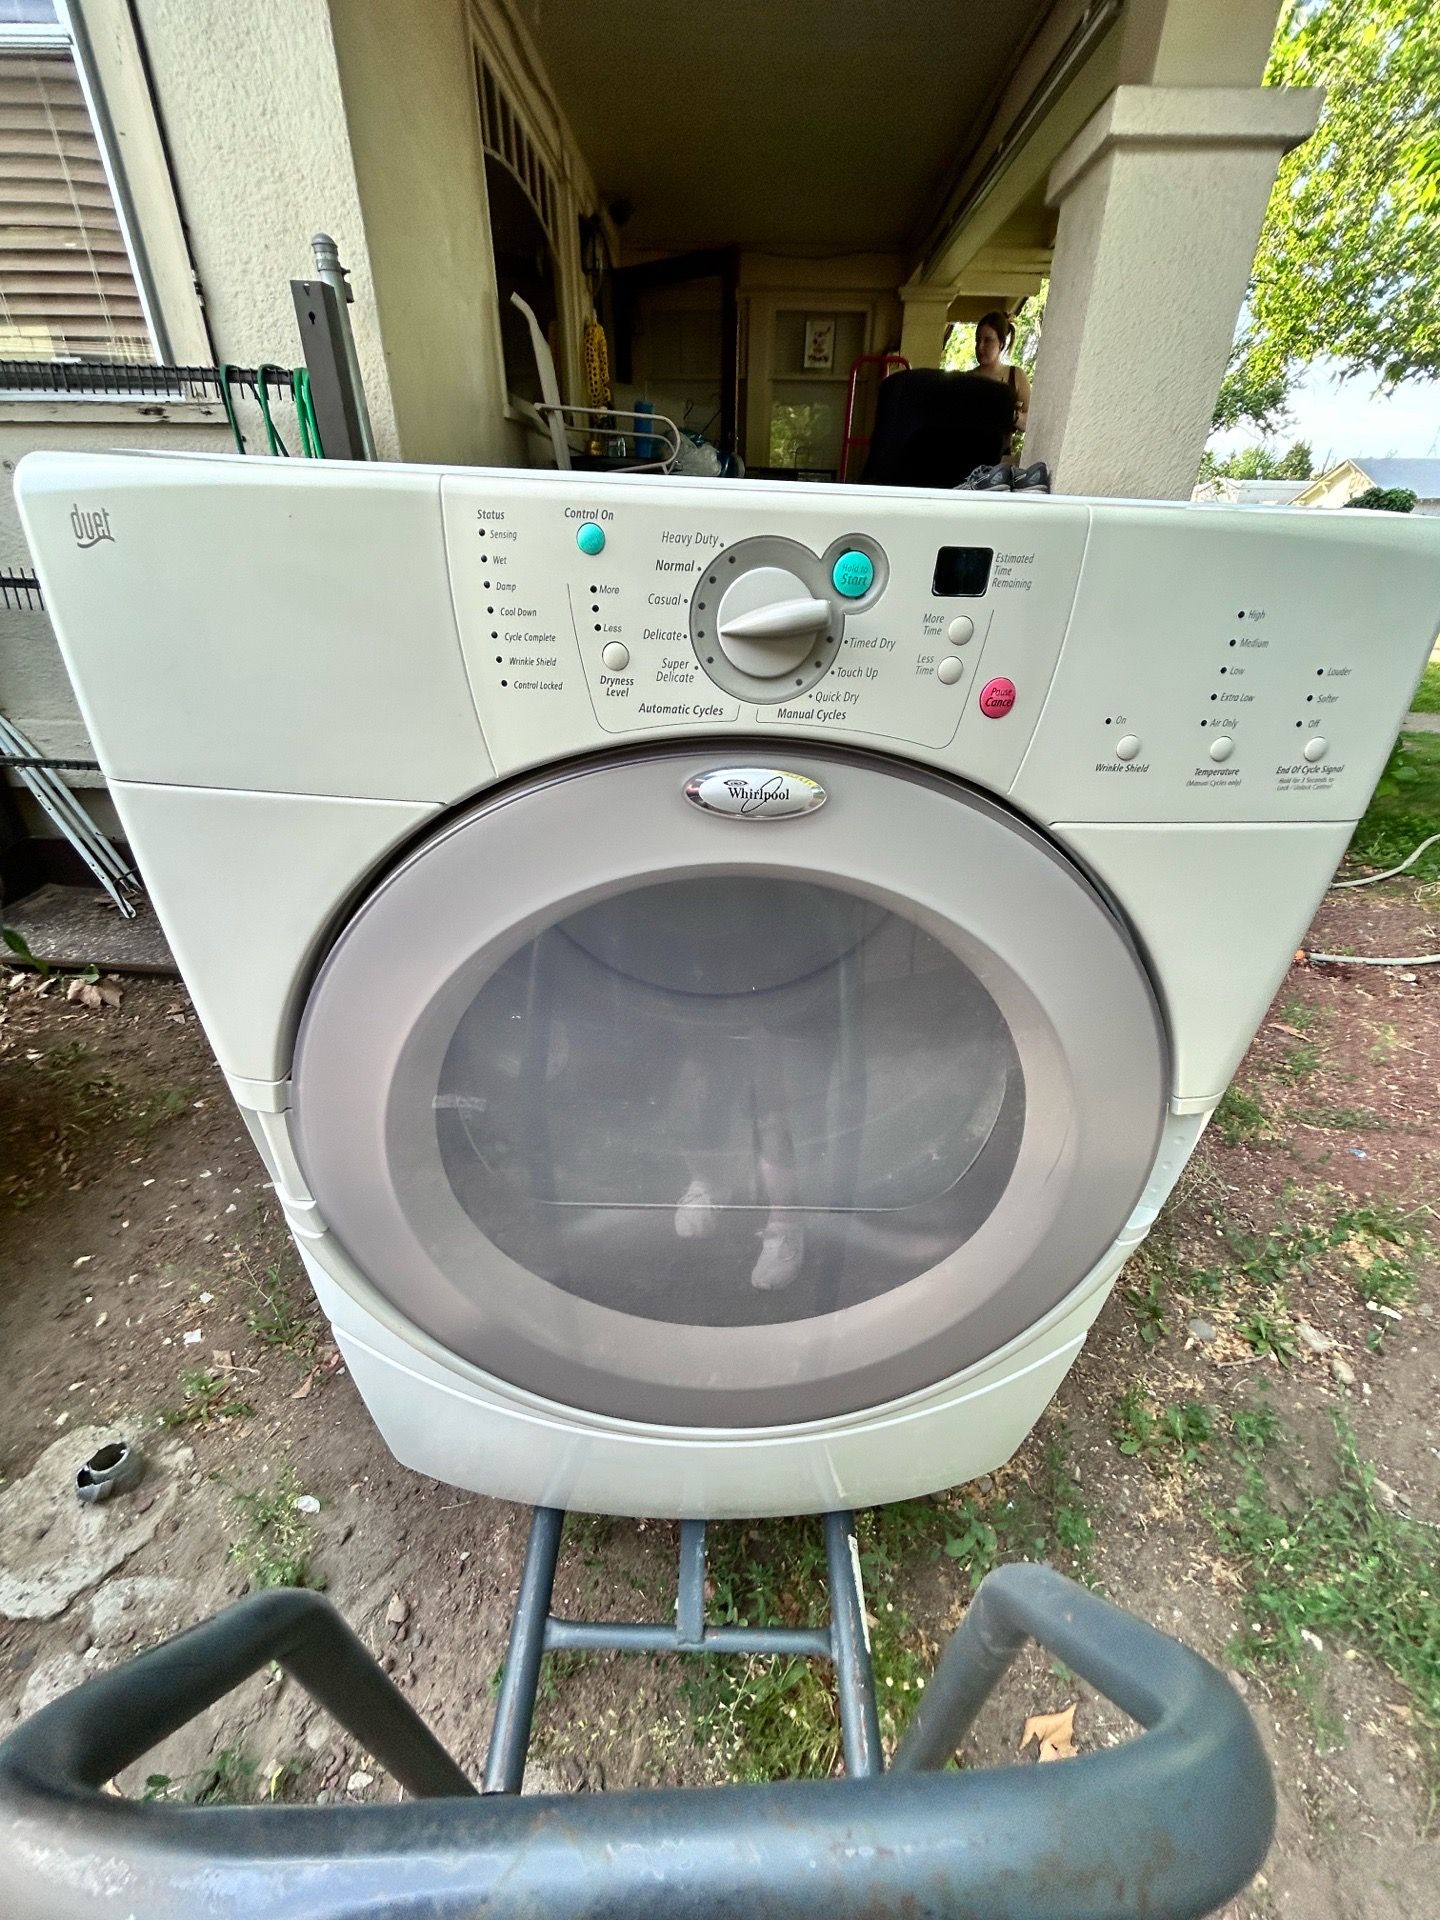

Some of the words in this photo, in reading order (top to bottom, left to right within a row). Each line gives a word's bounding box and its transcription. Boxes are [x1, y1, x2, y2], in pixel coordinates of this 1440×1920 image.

[477, 509, 505, 520] Status
[564, 508, 598, 519] Control
[601, 511, 614, 520] On
[490, 530, 517, 541] Sensing
[661, 531, 693, 544] Heavy
[695, 532, 718, 545] Duty
[493, 556, 507, 564] Wet
[996, 553, 1034, 564] Estimated
[655, 560, 694, 572] Normal
[994, 566, 1012, 576] Time
[841, 573, 868, 586] Start
[992, 578, 1032, 591] Remaining
[496, 582, 517, 592] Damp
[599, 586, 620, 594] More
[648, 594, 681, 605] Casual
[500, 607, 516, 616] Cool
[517, 608, 537, 616] Down
[1248, 610, 1266, 620] High
[923, 614, 944, 623] More
[643, 629, 682, 640] Delicate
[924, 627, 942, 635] Time
[504, 632, 522, 643] Cycle
[524, 633, 556, 643] Complete
[850, 637, 876, 648] Timed
[878, 638, 895, 651] Dry
[1239, 638, 1268, 648] Medium
[509, 656, 535, 666] Wrinkle
[536, 657, 557, 666] Shield
[662, 658, 688, 670] Super
[917, 655, 934, 663] Less
[837, 667, 863, 677] Touch
[865, 667, 878, 680] Up
[916, 666, 934, 675] Time
[1230, 667, 1245, 675] Low
[1327, 667, 1352, 676] Louder
[600, 676, 634, 687] Dryness
[656, 672, 694, 683] Delicate
[513, 680, 539, 690] Control
[539, 682, 563, 690] Locked
[606, 688, 629, 697] Level
[991, 688, 1012, 696] Pause
[815, 691, 842, 704] Quick
[843, 692, 859, 705] Dry
[985, 697, 1014, 707] Cancel
[1220, 693, 1239, 702] Extra
[1240, 694, 1255, 702] Low
[1317, 695, 1339, 703] Softer
[639, 703, 690, 715] Automatic
[692, 704, 723, 717] Cycles
[777, 708, 814, 719] Manual
[816, 709, 846, 721] Cycles
[1116, 716, 1126, 725] On
[1210, 719, 1222, 727] Air
[1222, 719, 1239, 729] Only
[1308, 720, 1320, 728] Off
[1095, 763, 1124, 772] Wrinkle
[1125, 764, 1149, 773] Shield
[1194, 768, 1240, 777] Temperature
[1276, 765, 1291, 774] End
[1291, 765, 1301, 773] Of
[1302, 765, 1320, 775] Cycle
[1321, 764, 1344, 775] Signal
[728, 787, 790, 803] Whirlpool
